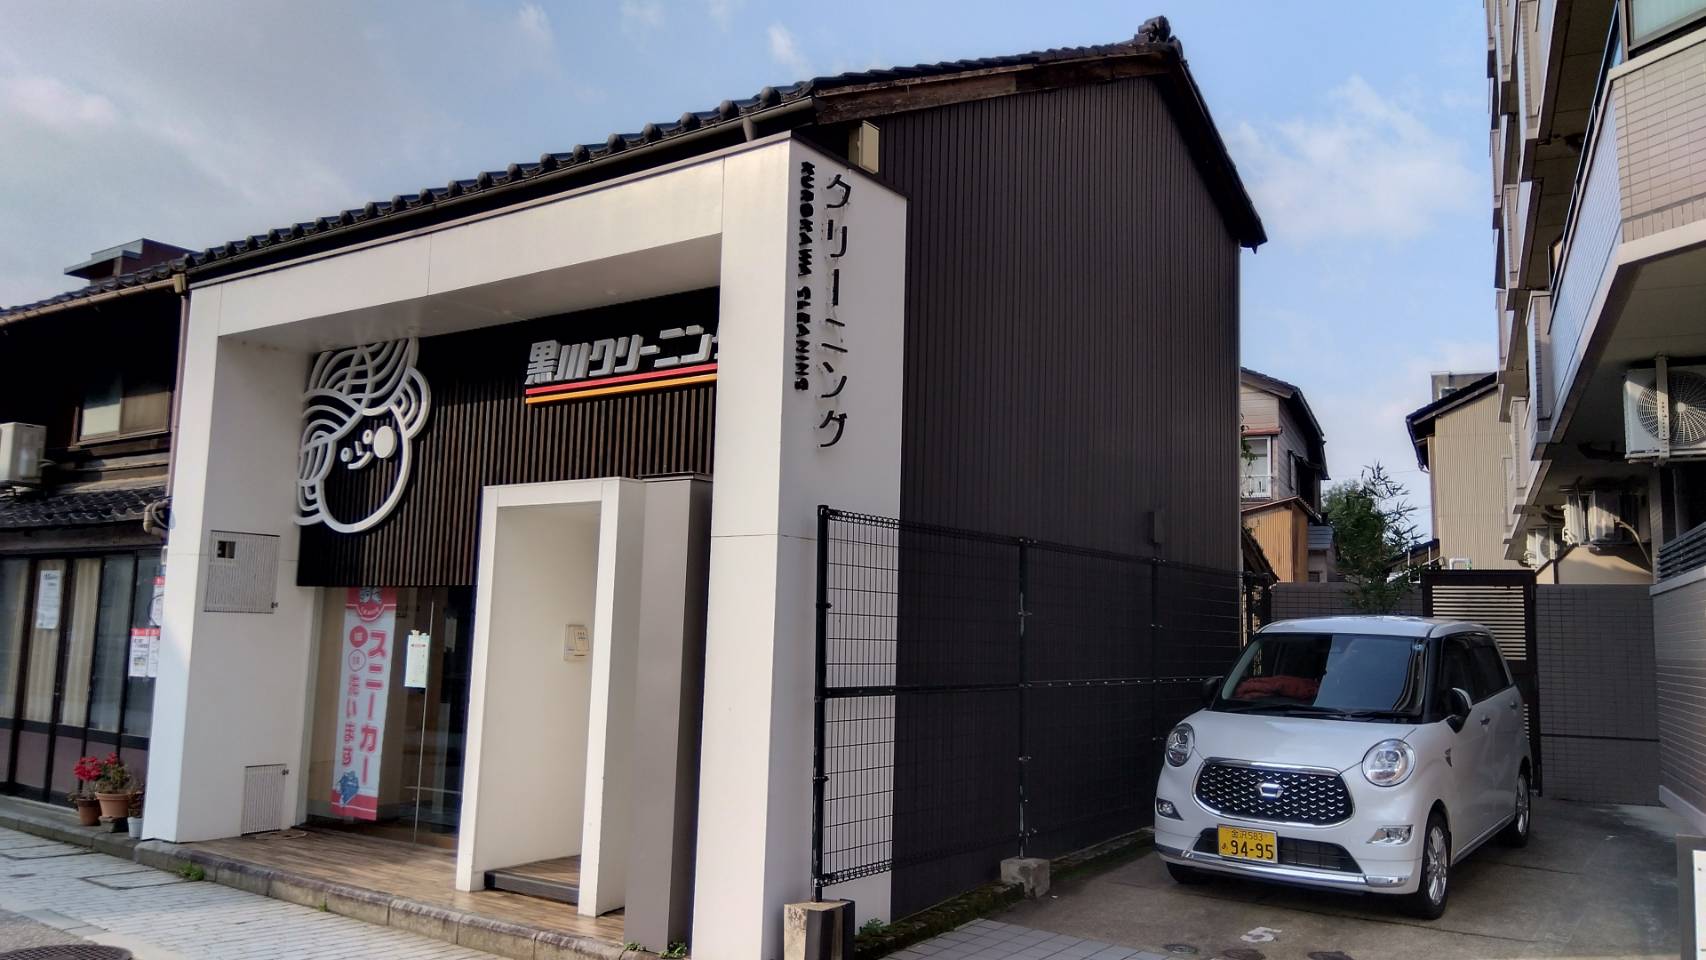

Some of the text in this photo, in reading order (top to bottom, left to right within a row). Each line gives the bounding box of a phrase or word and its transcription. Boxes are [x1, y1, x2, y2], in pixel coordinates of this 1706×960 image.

[795, 161, 815, 390] KUROKAWA CLEANING
[819, 174, 851, 448] クリーニング
[524, 324, 718, 385] 黒川クリーニン
[360, 630, 386, 785] スニーカー
[1230, 840, 1274, 860] 94-95
